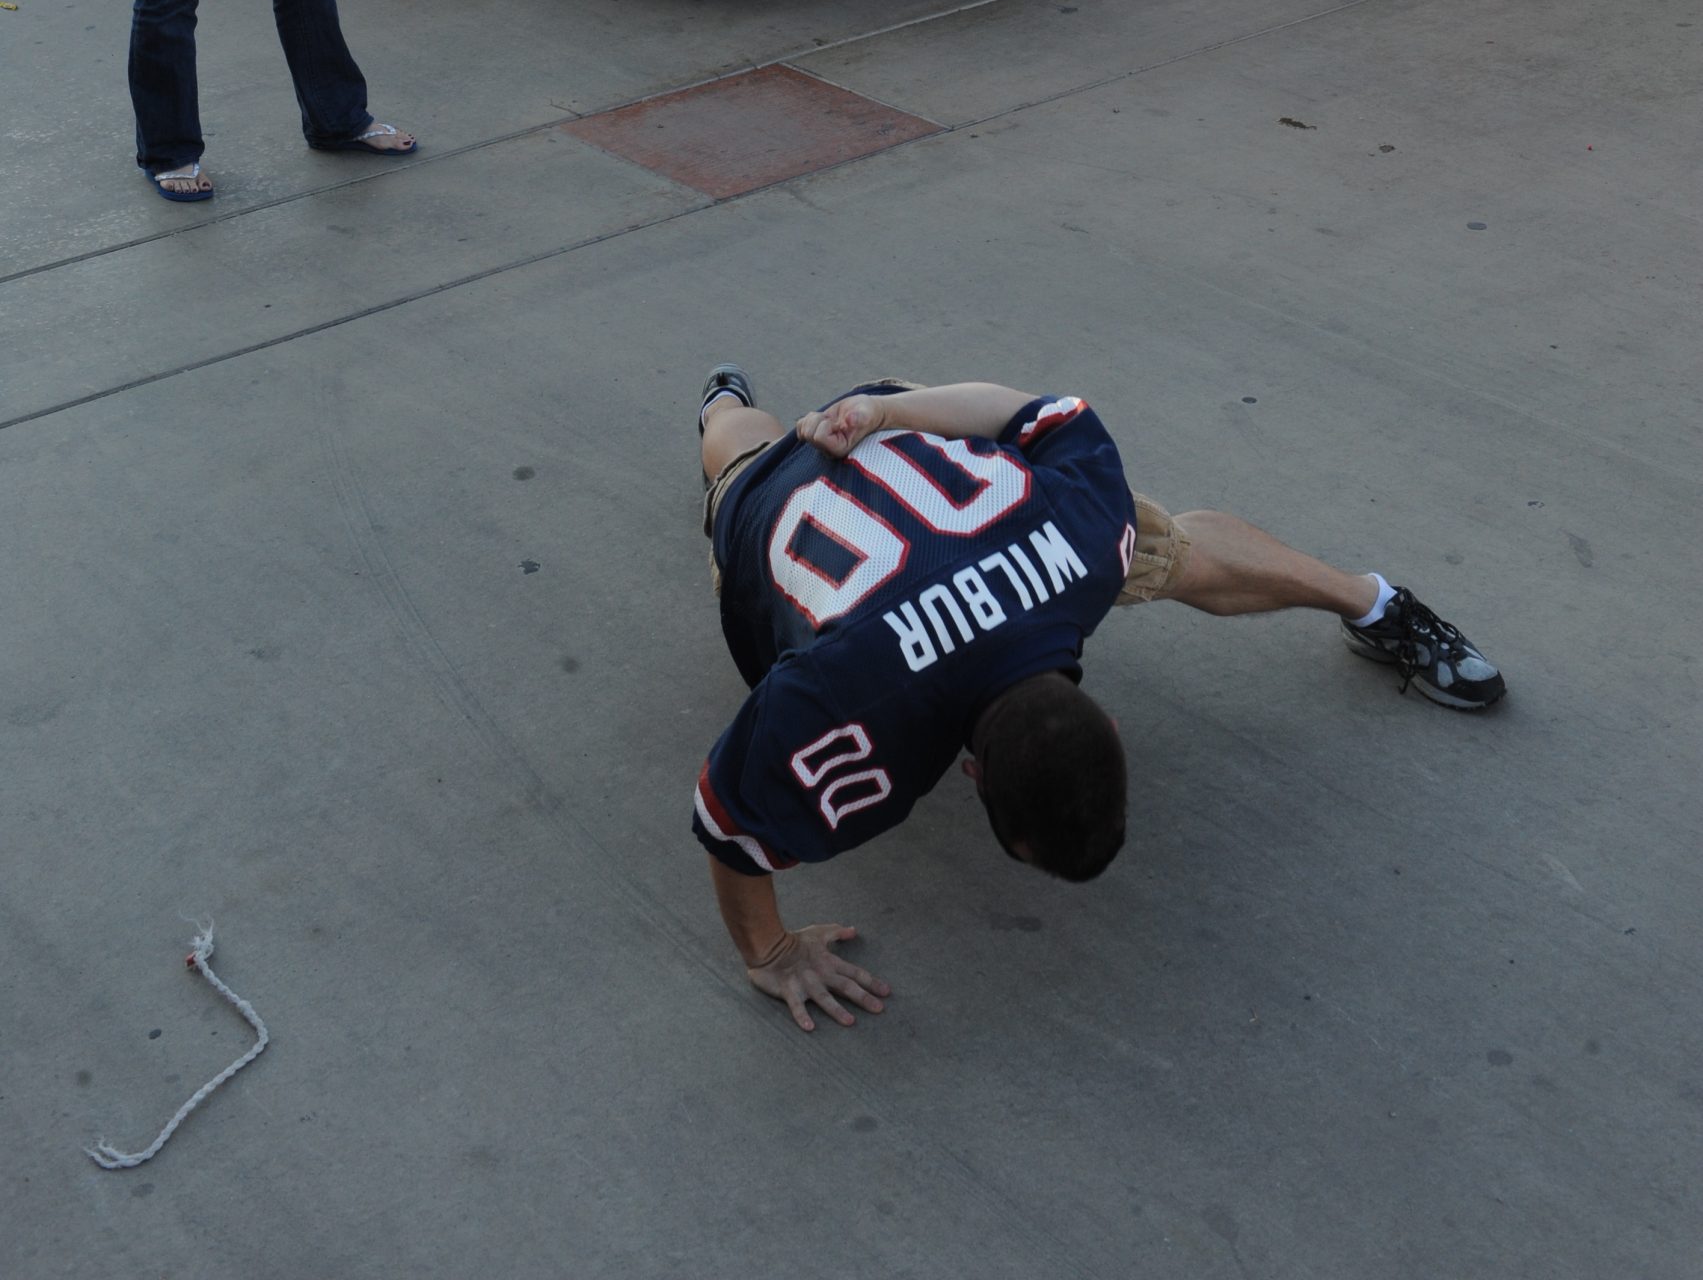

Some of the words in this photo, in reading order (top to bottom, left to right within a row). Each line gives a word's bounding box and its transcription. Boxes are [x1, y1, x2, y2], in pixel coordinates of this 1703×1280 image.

[882, 520, 1088, 673] WILBUR
[1119, 521, 1137, 578] 0
[790, 722, 893, 830] 00
